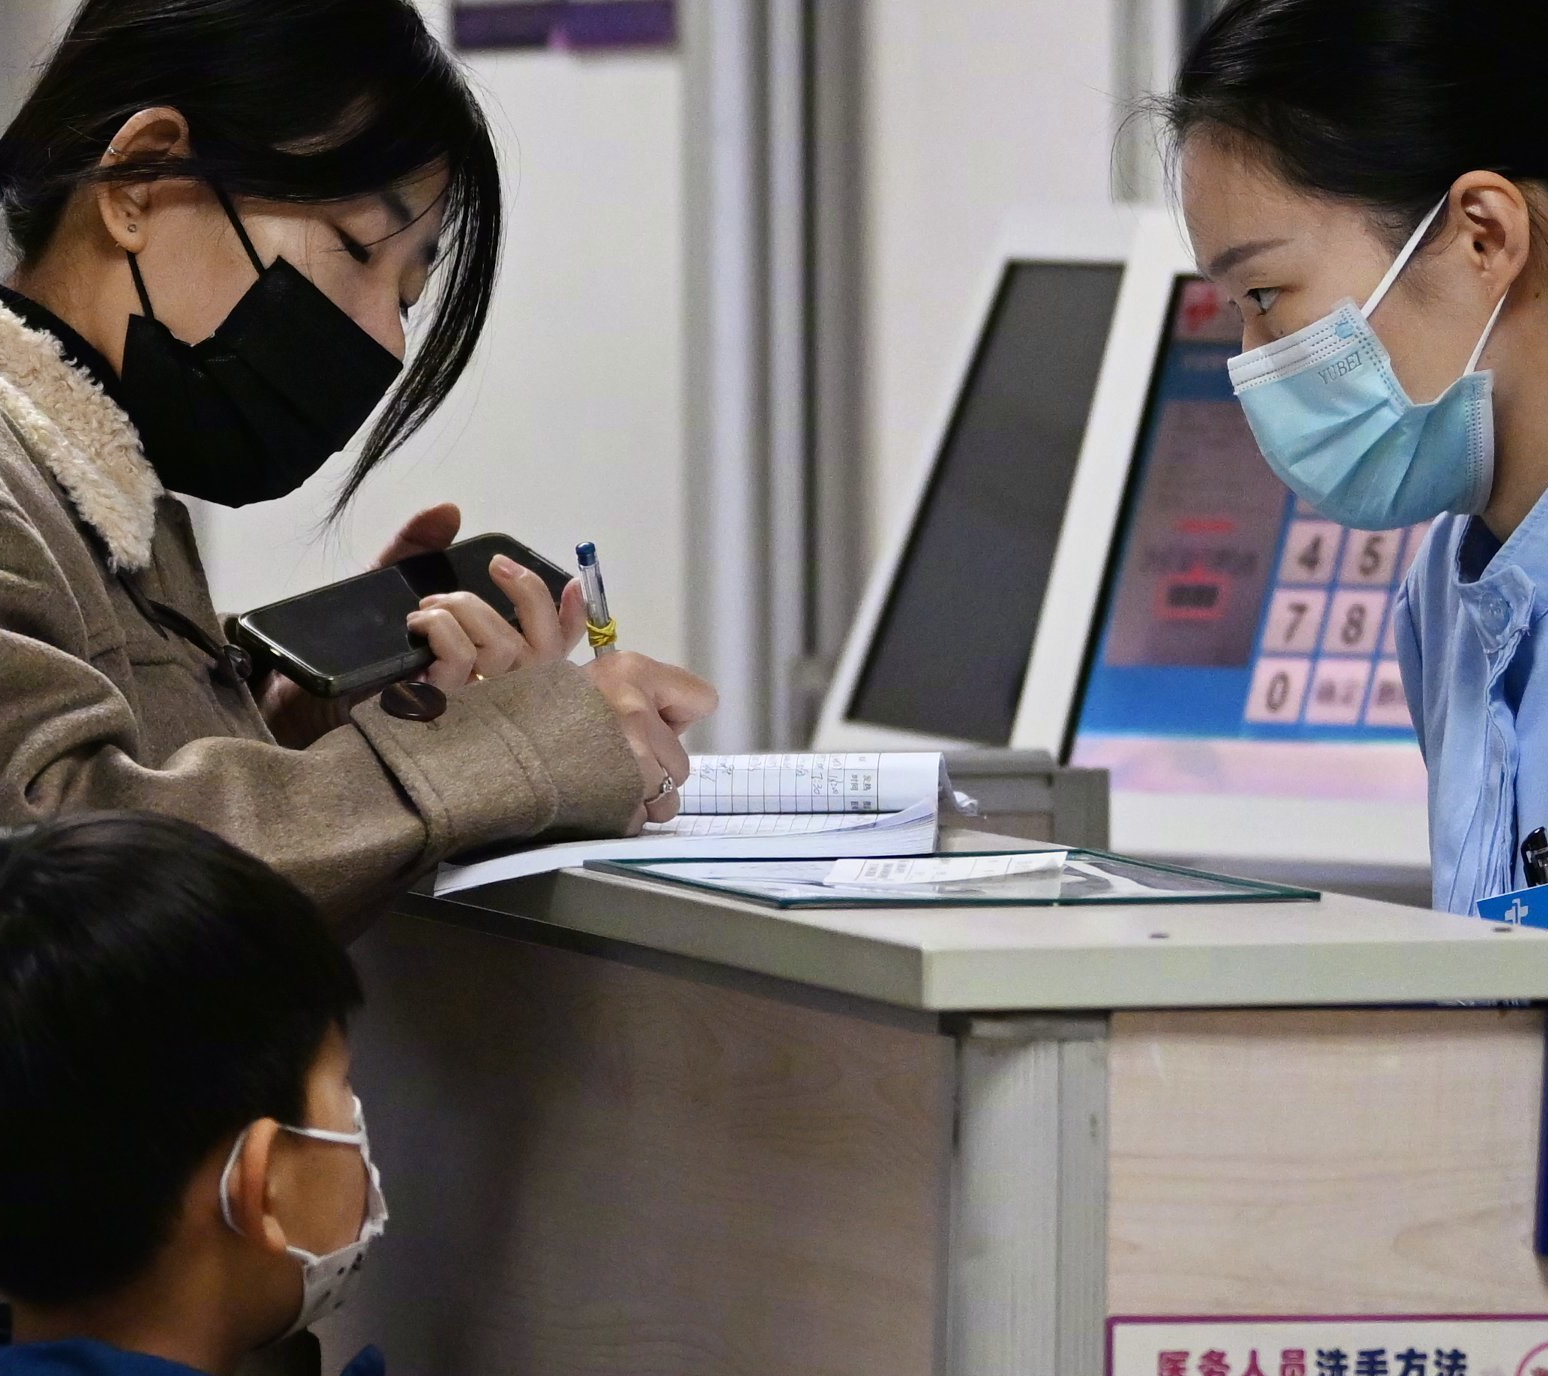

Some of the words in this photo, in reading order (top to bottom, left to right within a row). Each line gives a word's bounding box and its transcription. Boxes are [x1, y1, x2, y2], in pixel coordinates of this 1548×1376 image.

[1317, 351, 1363, 385] YUBEI
[1296, 534, 1321, 570] 4
[1358, 535, 1383, 575] 5
[1286, 603, 1310, 642] 7
[1341, 605, 1366, 644] 8
[1266, 671, 1290, 713] 0
